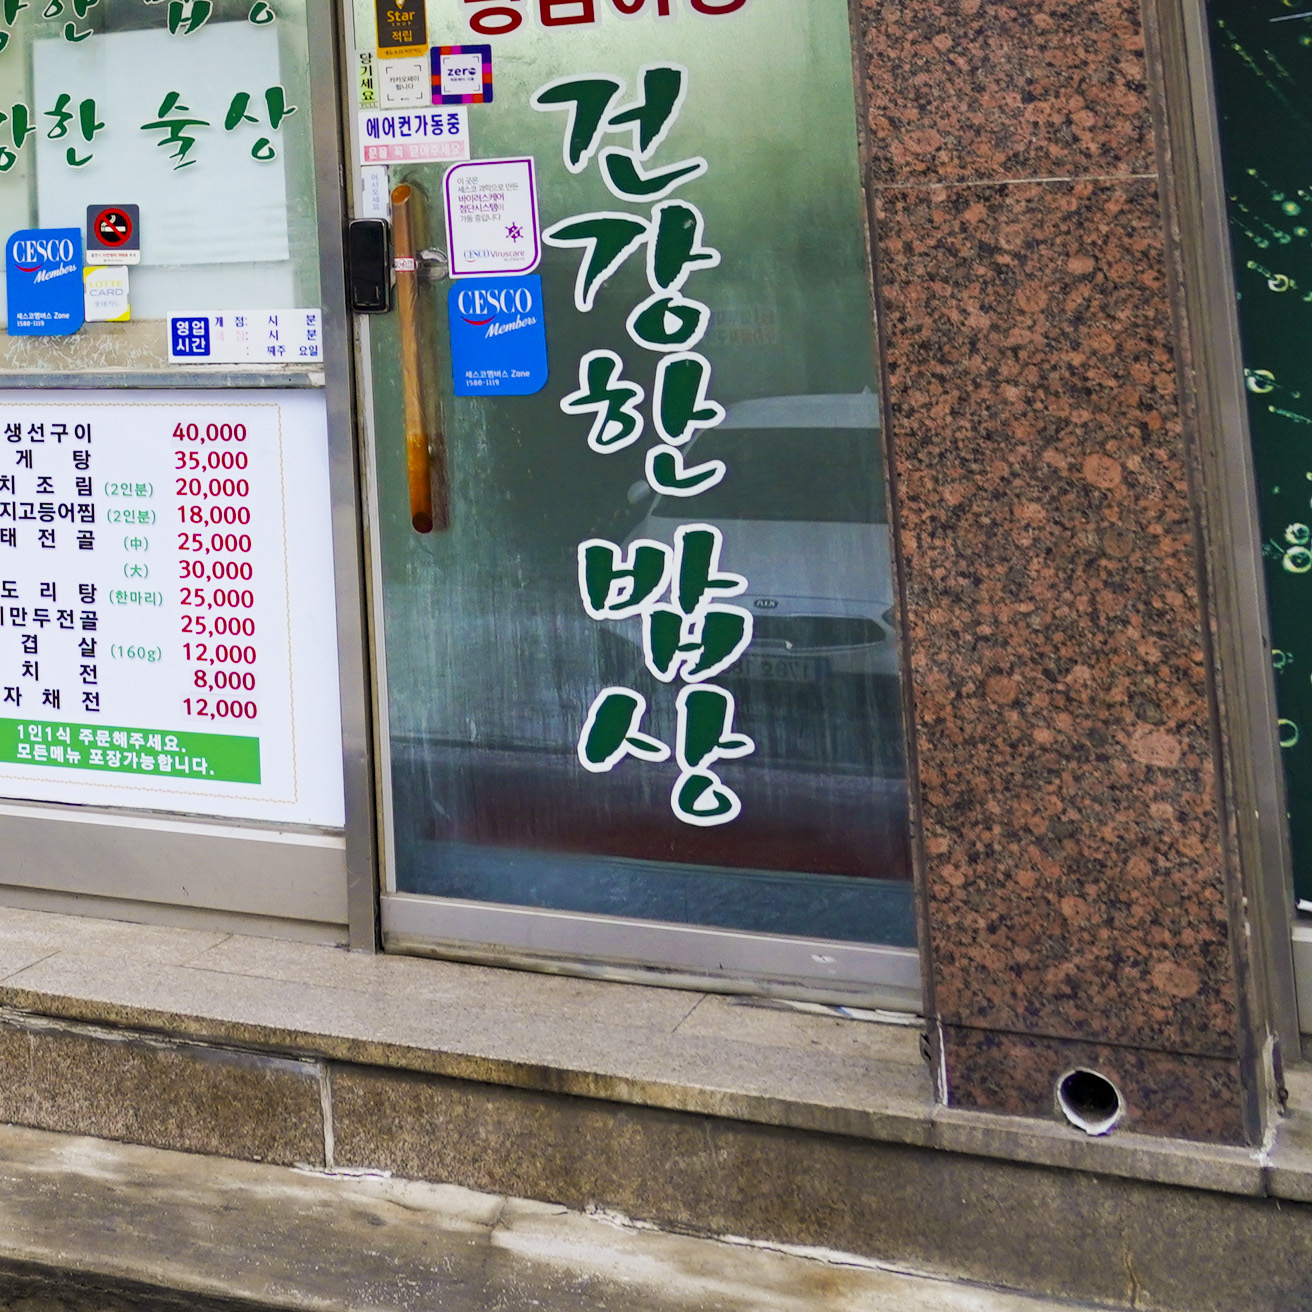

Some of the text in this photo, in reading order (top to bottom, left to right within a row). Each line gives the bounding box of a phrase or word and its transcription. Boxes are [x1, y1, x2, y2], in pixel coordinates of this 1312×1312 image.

[387, 10, 415, 23] Star
[392, 29, 413, 42] 적립
[360, 52, 375, 100] 당기세요
[140, 86, 297, 171] 술상
[458, 192, 505, 203] 바이러스케어
[12, 238, 74, 264] CESCO
[463, 249, 525, 259] CESCO Viruscare
[33, 262, 78, 285] Members
[89, 280, 123, 288] LOTTE
[536, 68, 719, 490] 건강한
[89, 288, 124, 297] CARD
[458, 288, 533, 315] CESCO
[53, 311, 70, 320] Zone
[268, 314, 316, 326] 시 분
[485, 314, 538, 339] Members
[176, 321, 205, 336] 영업
[269, 329, 317, 341] 시 분
[176, 337, 206, 353] 시간
[299, 344, 318, 357] 요일
[511, 369, 531, 378] Zone
[172, 422, 247, 444] 40,000
[174, 451, 248, 472] 35,000
[104, 482, 153, 497] (2인분)
[175, 478, 250, 500] 20,000
[107, 509, 156, 525] (2인분)
[177, 505, 251, 527] 18,000
[123, 536, 149, 552] (中)
[177, 532, 252, 555] 25,000
[123, 560, 253, 582] (大) 30,000
[109, 589, 163, 606] (한마리)
[180, 587, 254, 610] 25,000
[181, 615, 255, 638] 25,000
[110, 643, 162, 663] (160g)
[182, 642, 257, 666] 12,000
[194, 669, 256, 692] 8,000
[583, 528, 748, 818] 밥상
[183, 698, 258, 720] 12,000
[17, 724, 187, 753] 1인1식 주문해주세요.
[17, 743, 216, 776] 모든메뉴 포장가능합니다.
